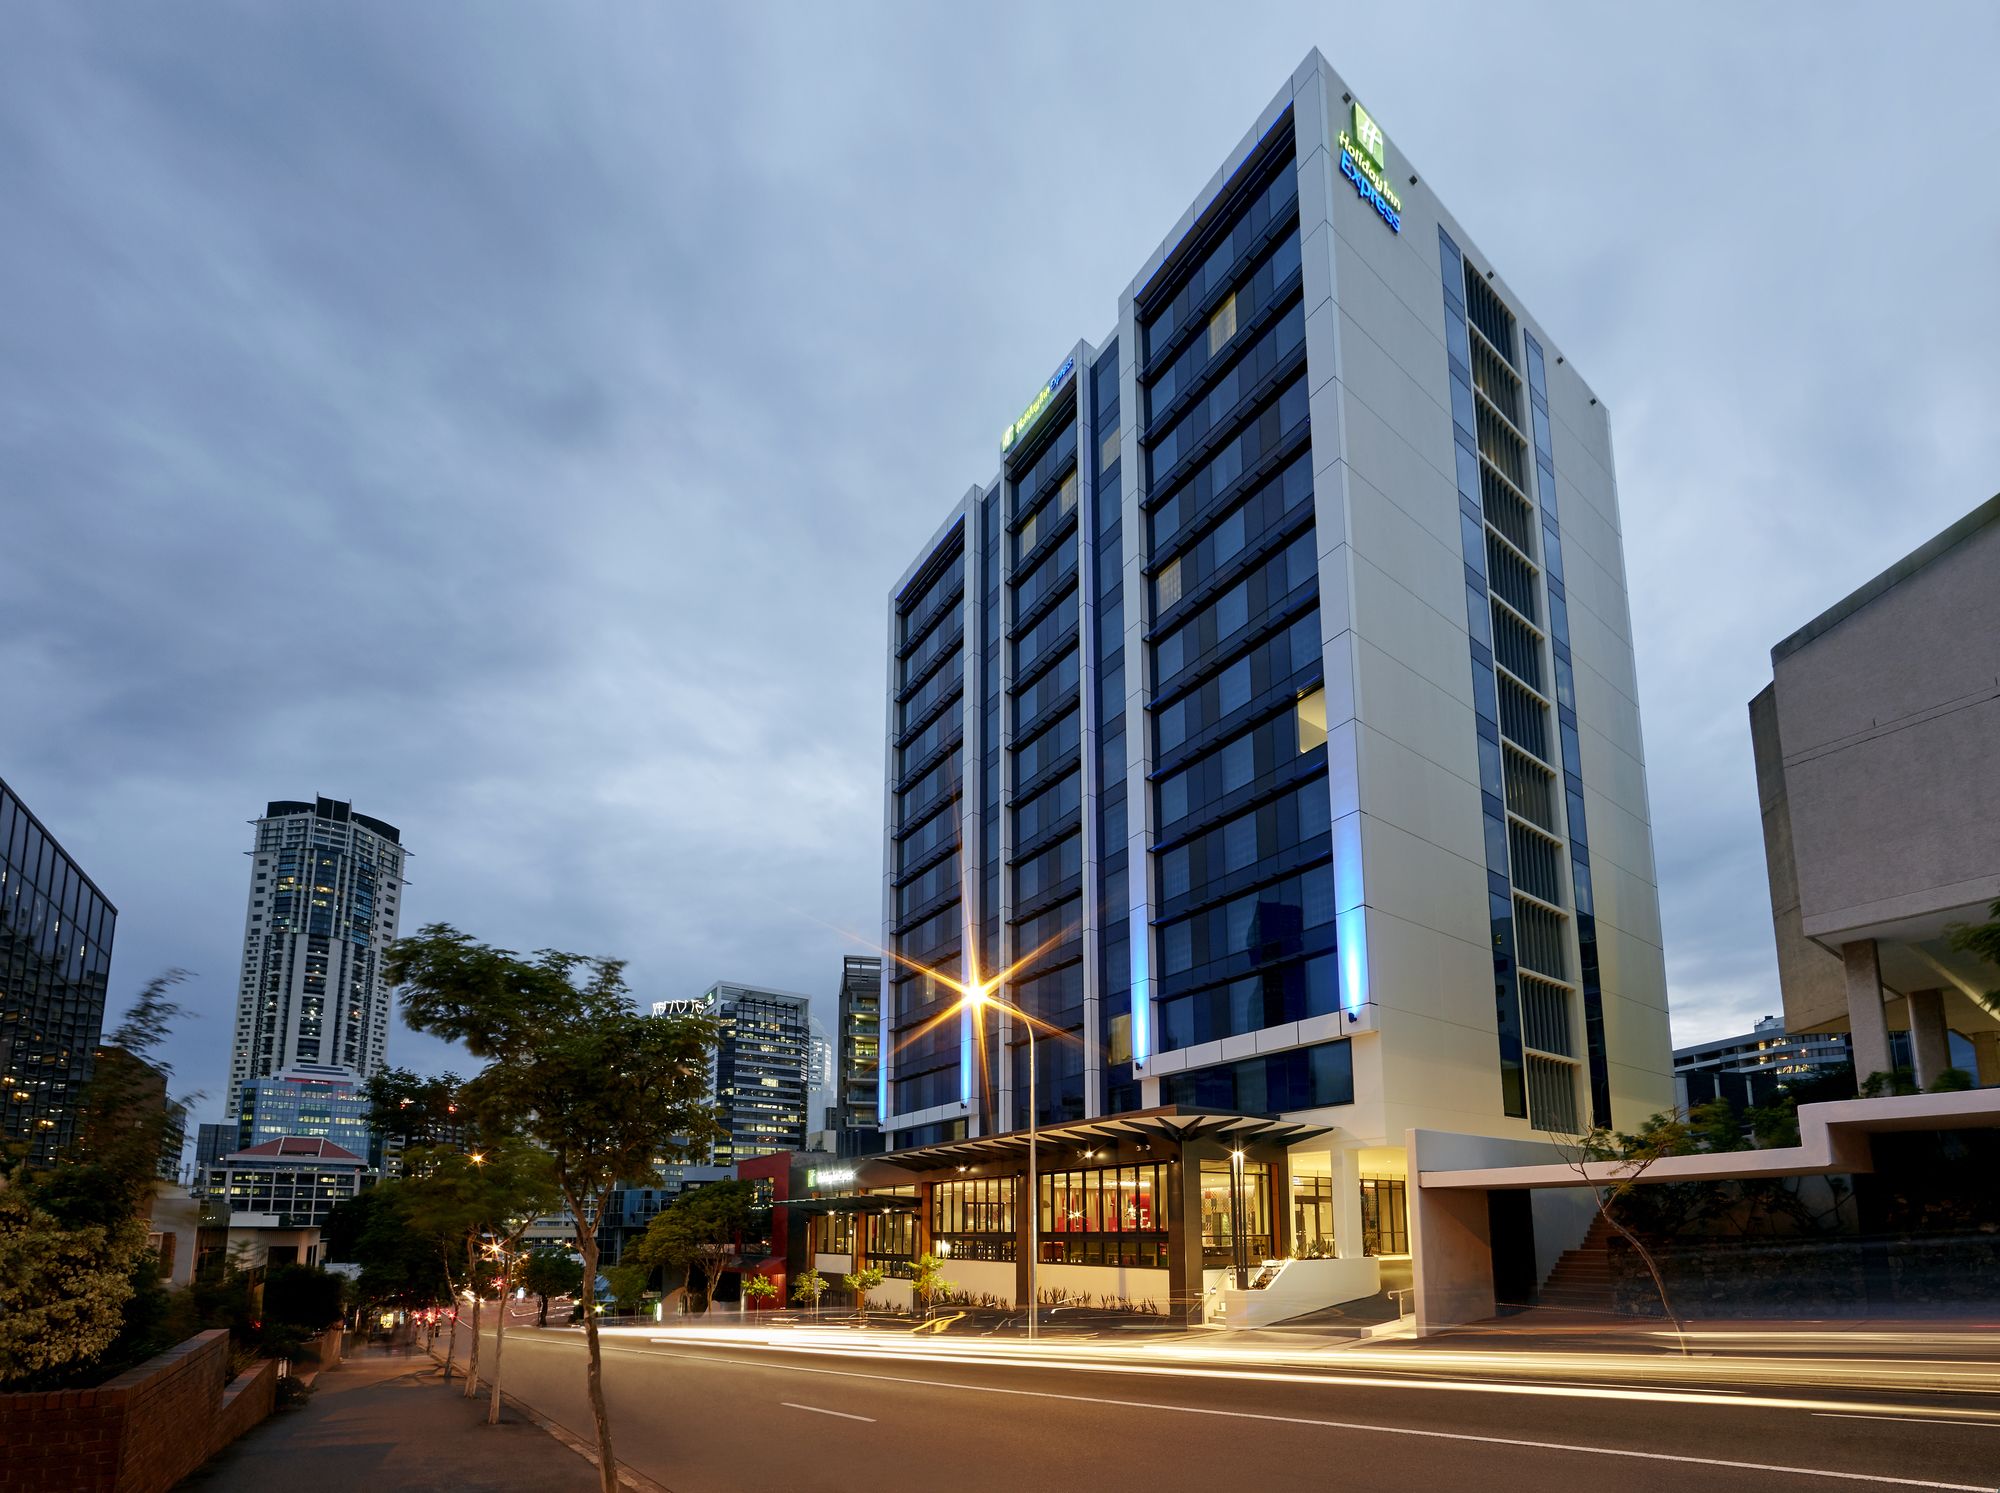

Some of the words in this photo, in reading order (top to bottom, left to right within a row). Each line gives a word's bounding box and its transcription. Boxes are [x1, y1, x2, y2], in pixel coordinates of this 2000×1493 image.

[1339, 130, 1383, 193] Holiday
[1383, 180, 1401, 212] Inn
[1340, 148, 1401, 232] Express
